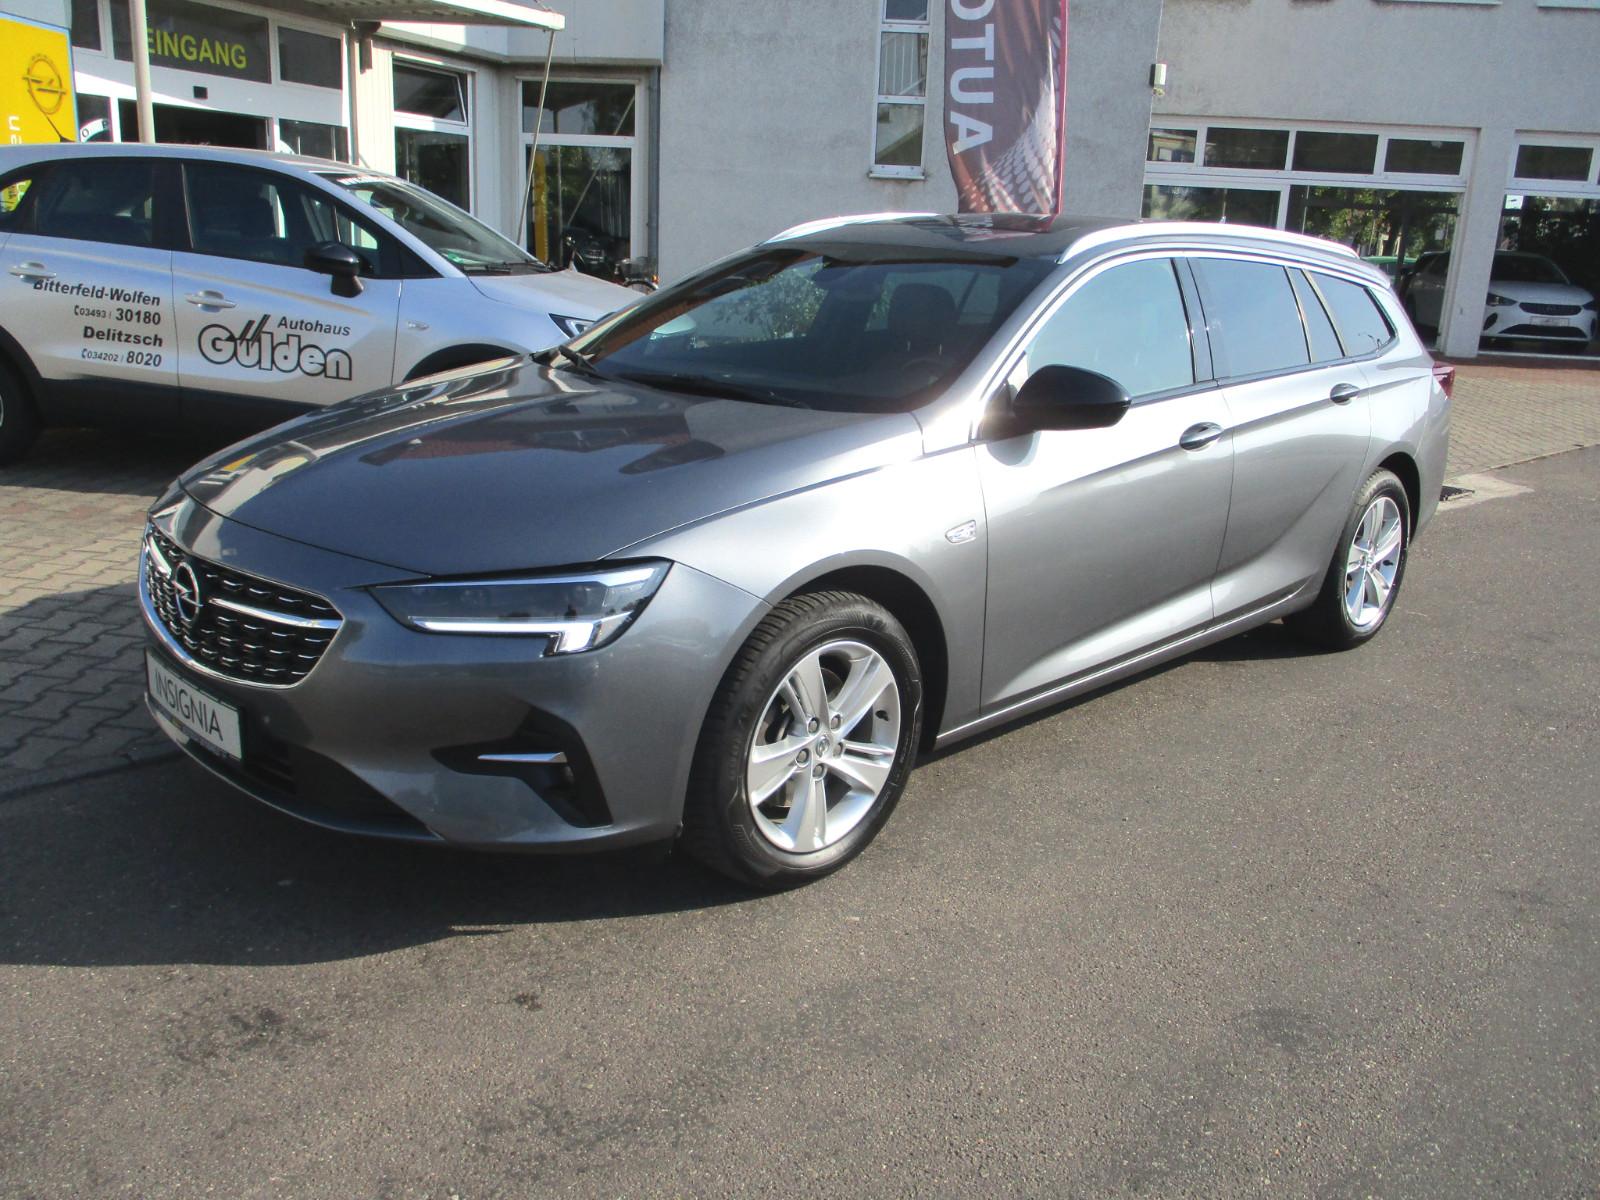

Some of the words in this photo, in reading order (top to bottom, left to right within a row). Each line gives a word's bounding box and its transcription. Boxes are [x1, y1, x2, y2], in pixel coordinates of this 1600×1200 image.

[146, 27, 247, 69] EINGANG
[33, 278, 161, 306] Bitterfeld-Wolfen
[79, 307, 107, 319] 03493
[115, 308, 162, 325] 30180
[277, 315, 351, 337] Autohaus
[83, 325, 163, 347] Delitzsch
[198, 314, 353, 381] Gülden
[126, 350, 162, 367] 8020
[156, 670, 224, 741] INSIGNIA
